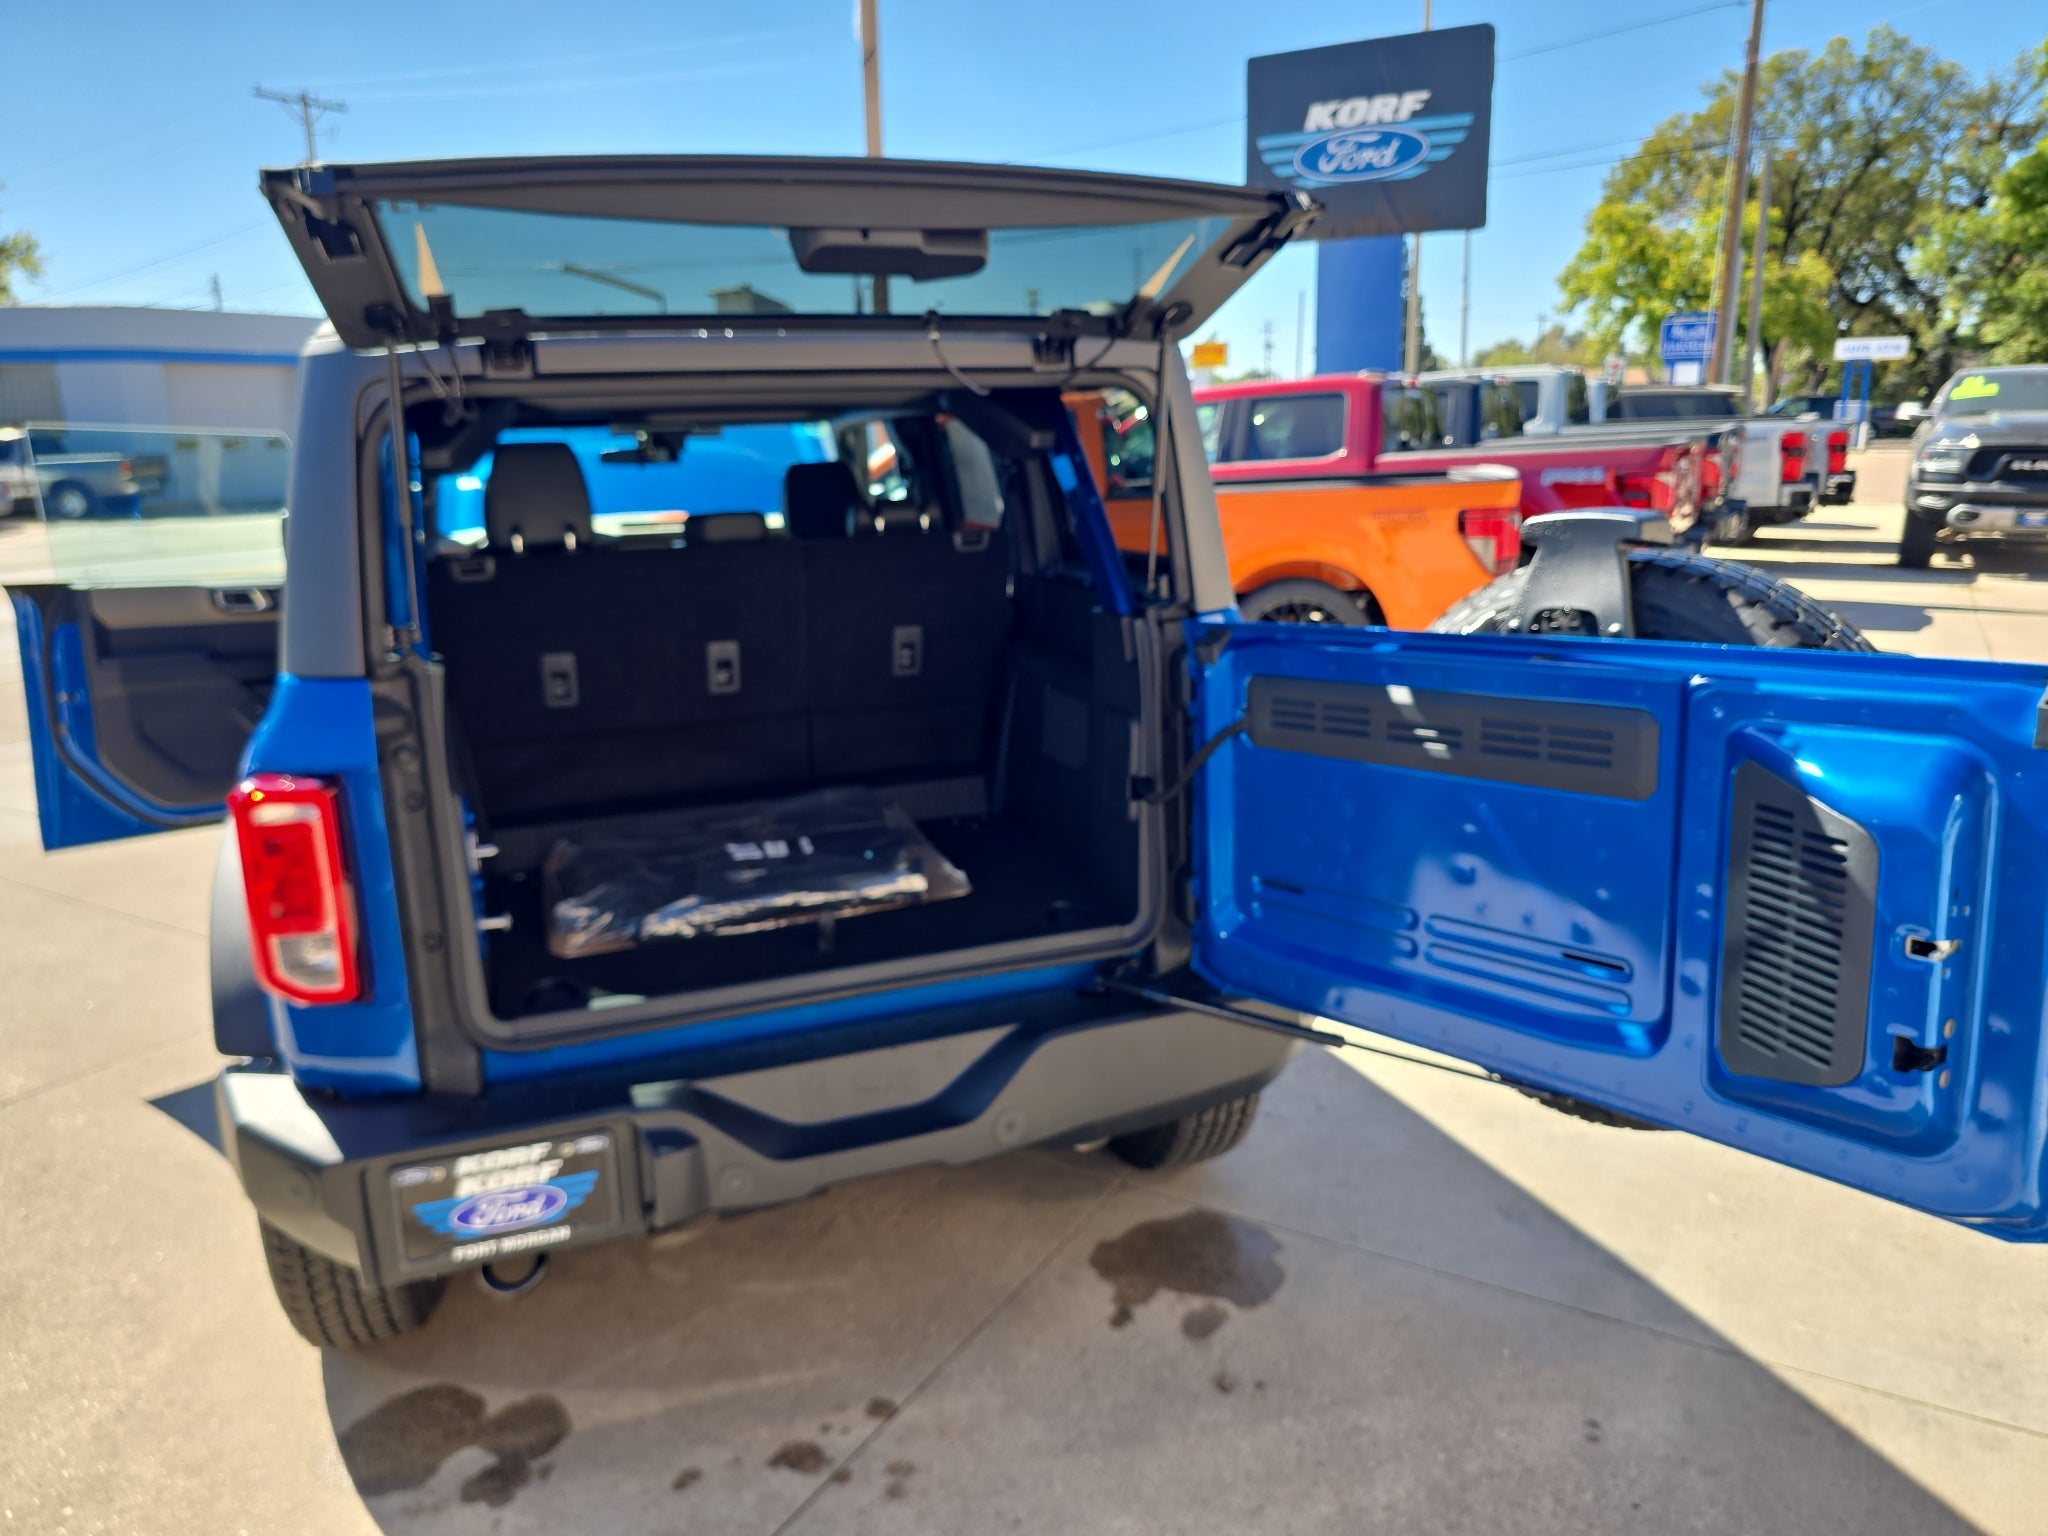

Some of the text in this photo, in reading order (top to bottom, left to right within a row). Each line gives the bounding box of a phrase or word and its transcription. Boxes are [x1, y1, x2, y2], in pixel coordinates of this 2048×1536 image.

[1303, 89, 1432, 133] KORF
[1318, 132, 1402, 174] Ford
[470, 1190, 548, 1226] Ford
